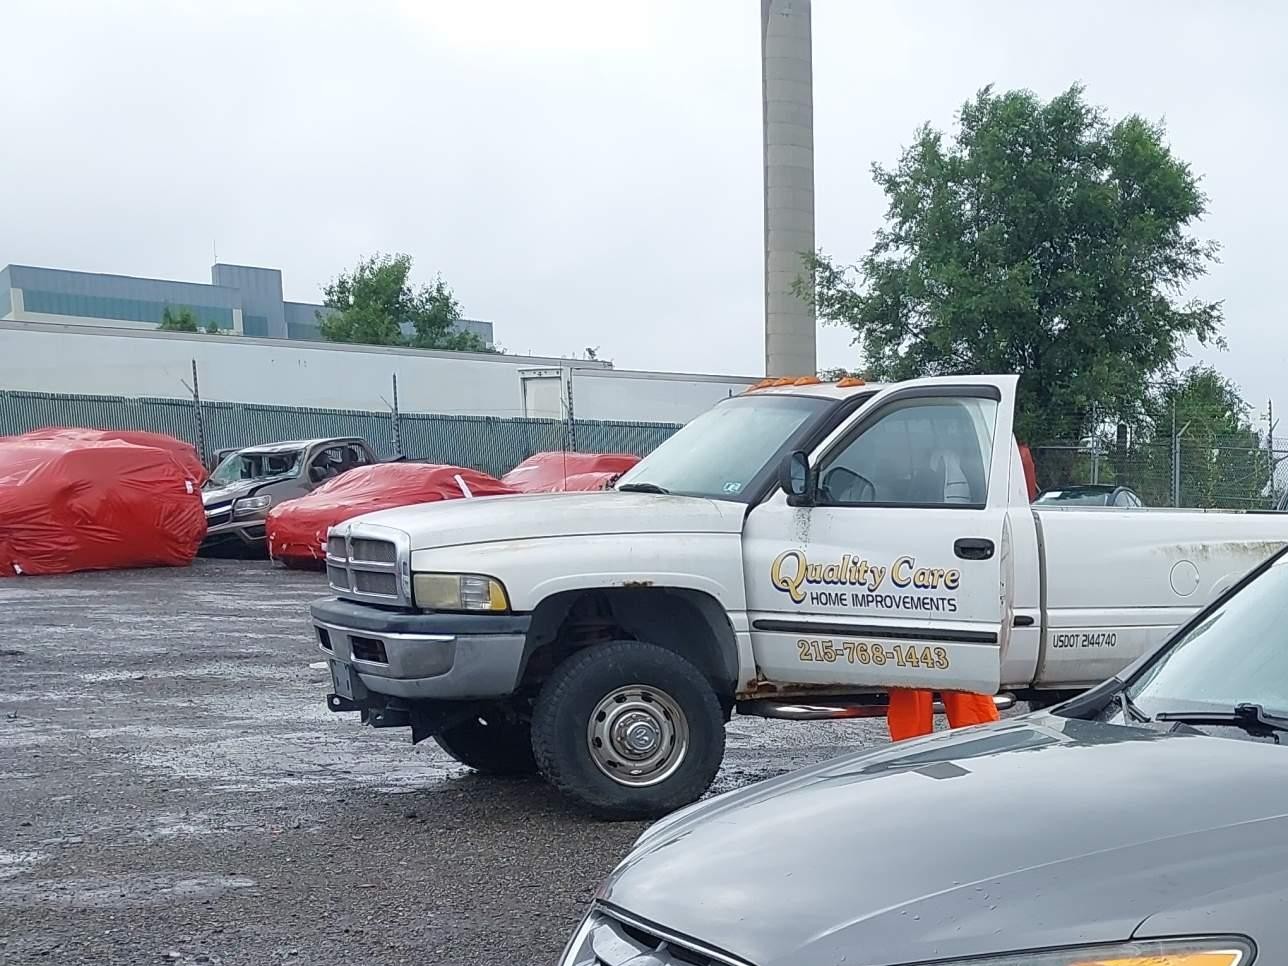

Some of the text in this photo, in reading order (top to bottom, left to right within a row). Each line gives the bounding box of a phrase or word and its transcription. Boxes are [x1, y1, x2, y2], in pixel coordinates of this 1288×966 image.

[770, 549, 961, 604] Quality Care
[811, 592, 957, 612] HOME IMPROVEMENTS
[1053, 633, 1117, 648] USDOT 2144740
[797, 639, 949, 669] 215-768-1443
